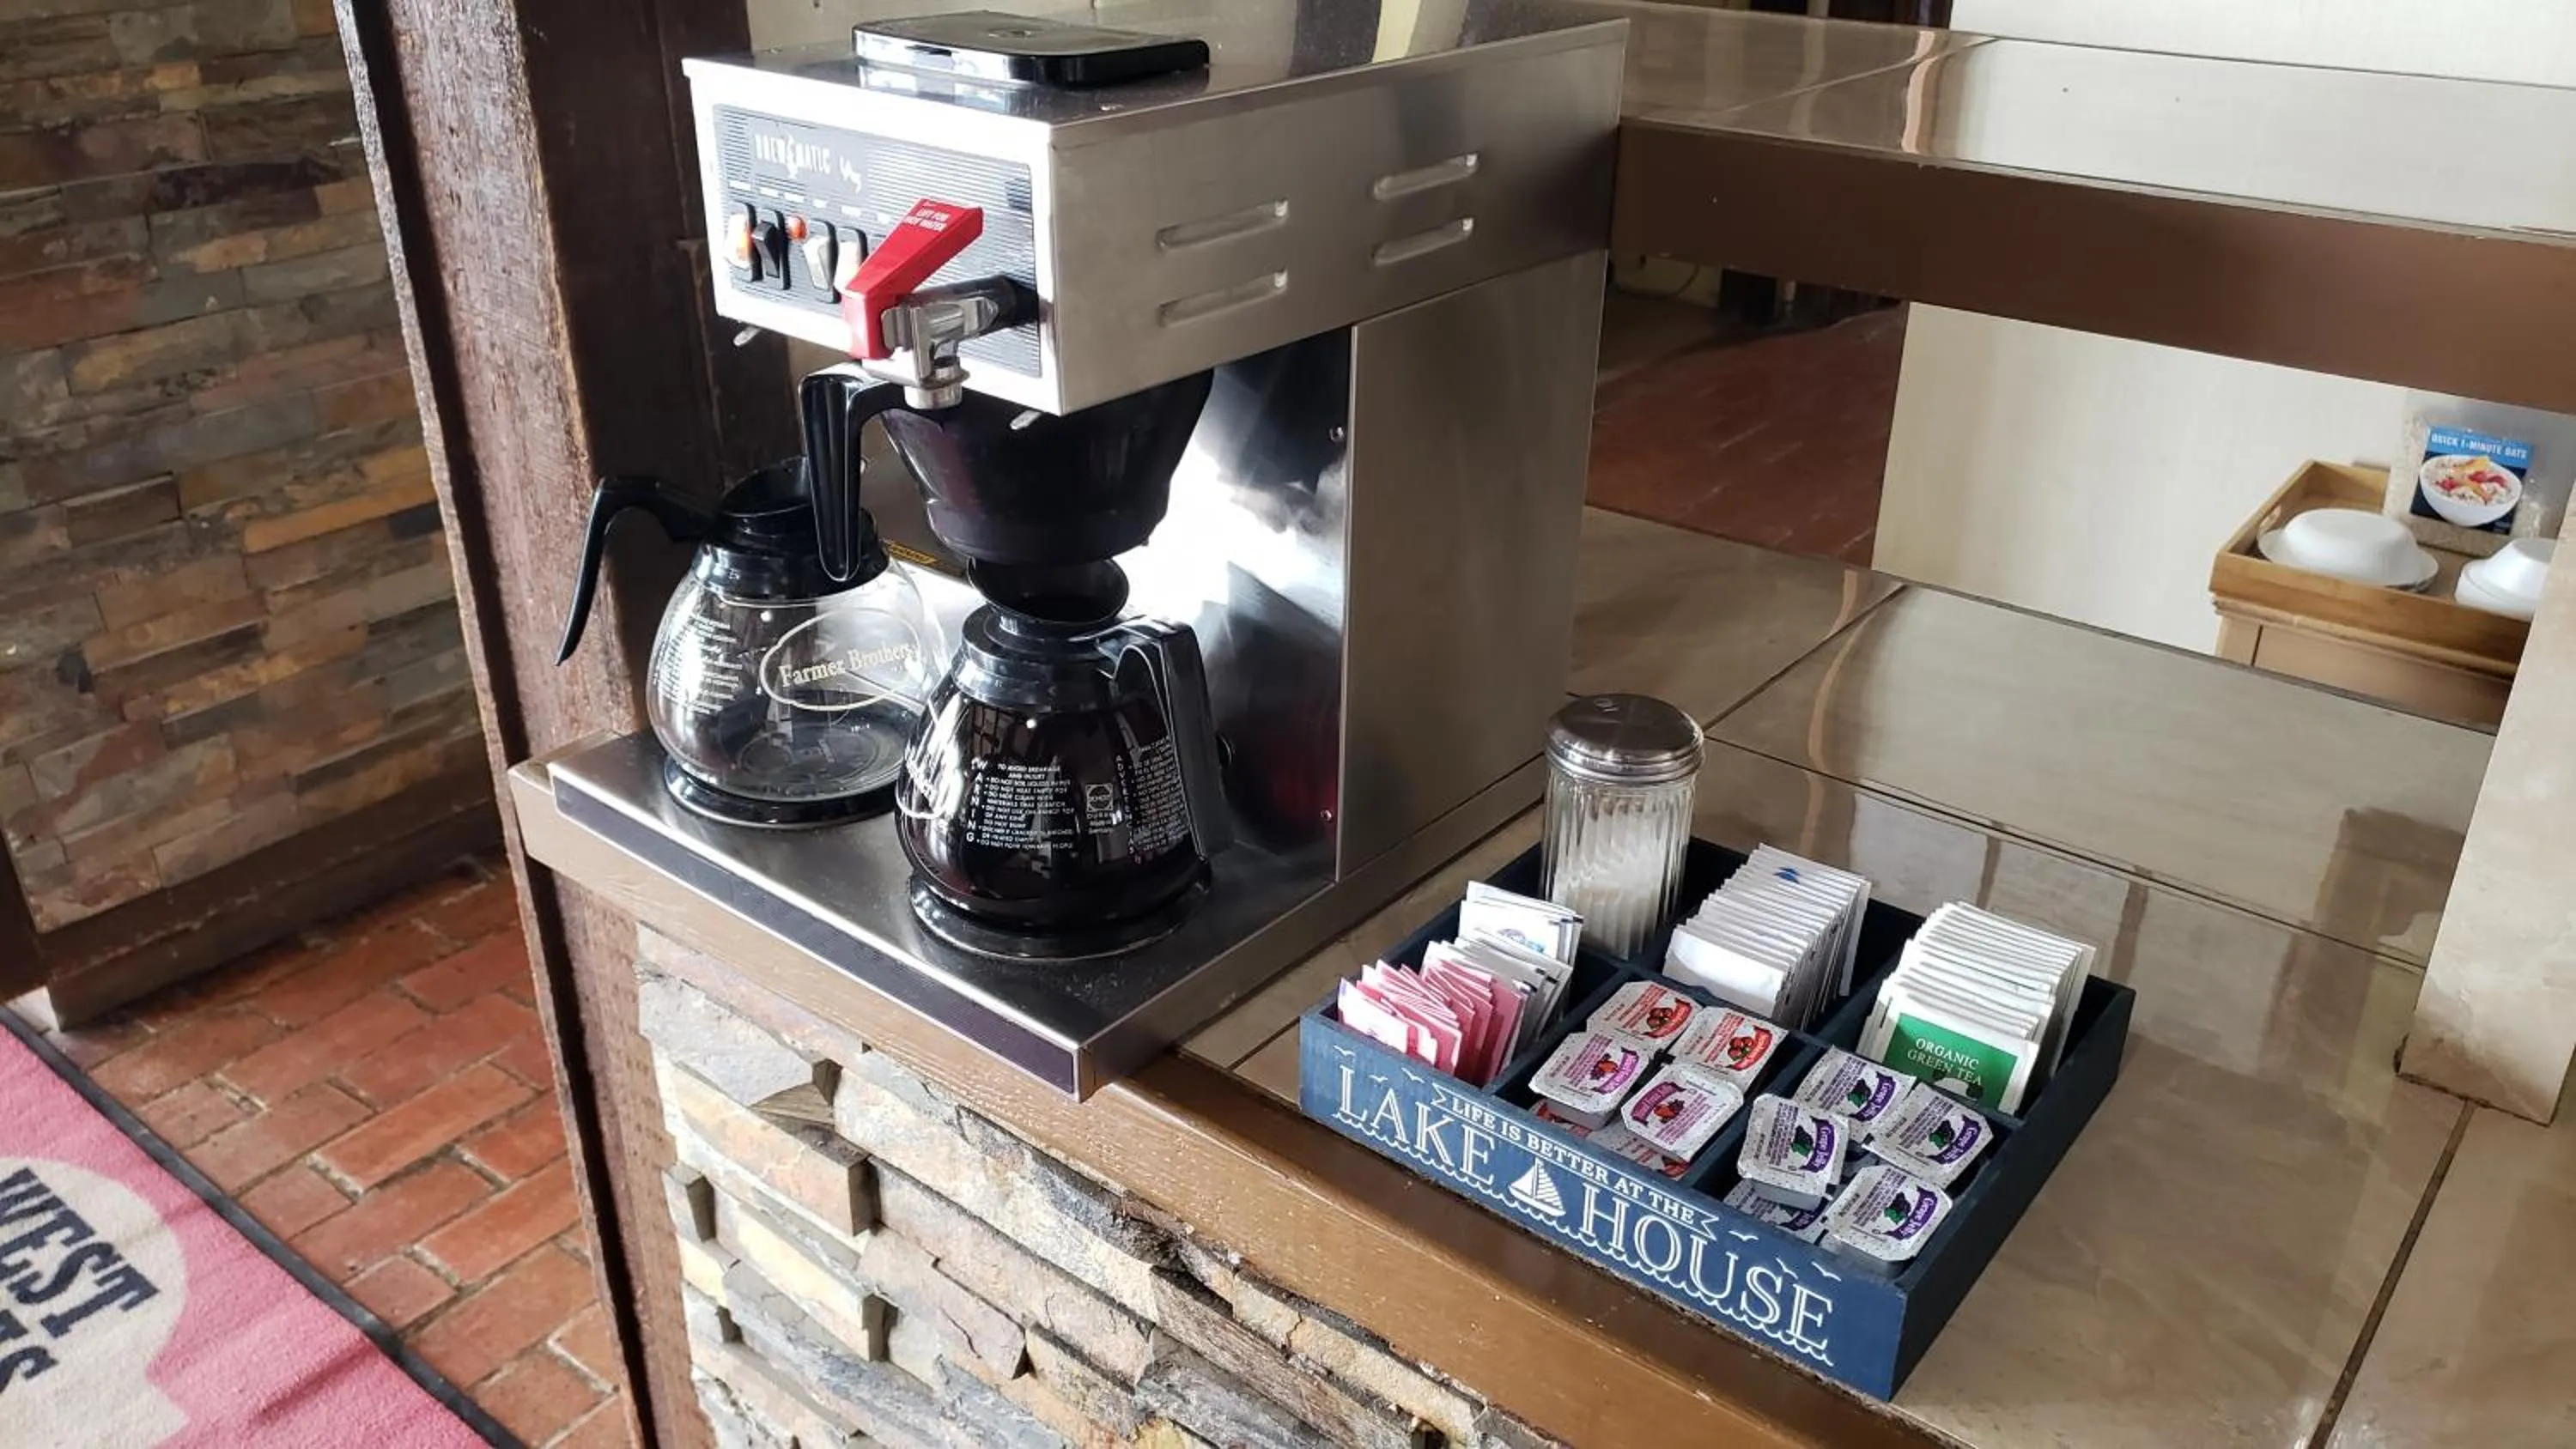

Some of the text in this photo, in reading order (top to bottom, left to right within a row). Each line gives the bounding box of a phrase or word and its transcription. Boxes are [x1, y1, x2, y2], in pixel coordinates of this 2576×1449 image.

[2431, 433, 2528, 459] QUICK 1-MINUTE OATS
[779, 659, 847, 687] Farmer
[1907, 1049, 1982, 1086] GREEN TEA
[1916, 1038, 1979, 1070] ORGANIC
[1452, 1097, 1696, 1226] LIFE IS BETTER AT THE
[1339, 1064, 1496, 1186] LAKE
[1579, 1182, 1833, 1351] HOUSE
